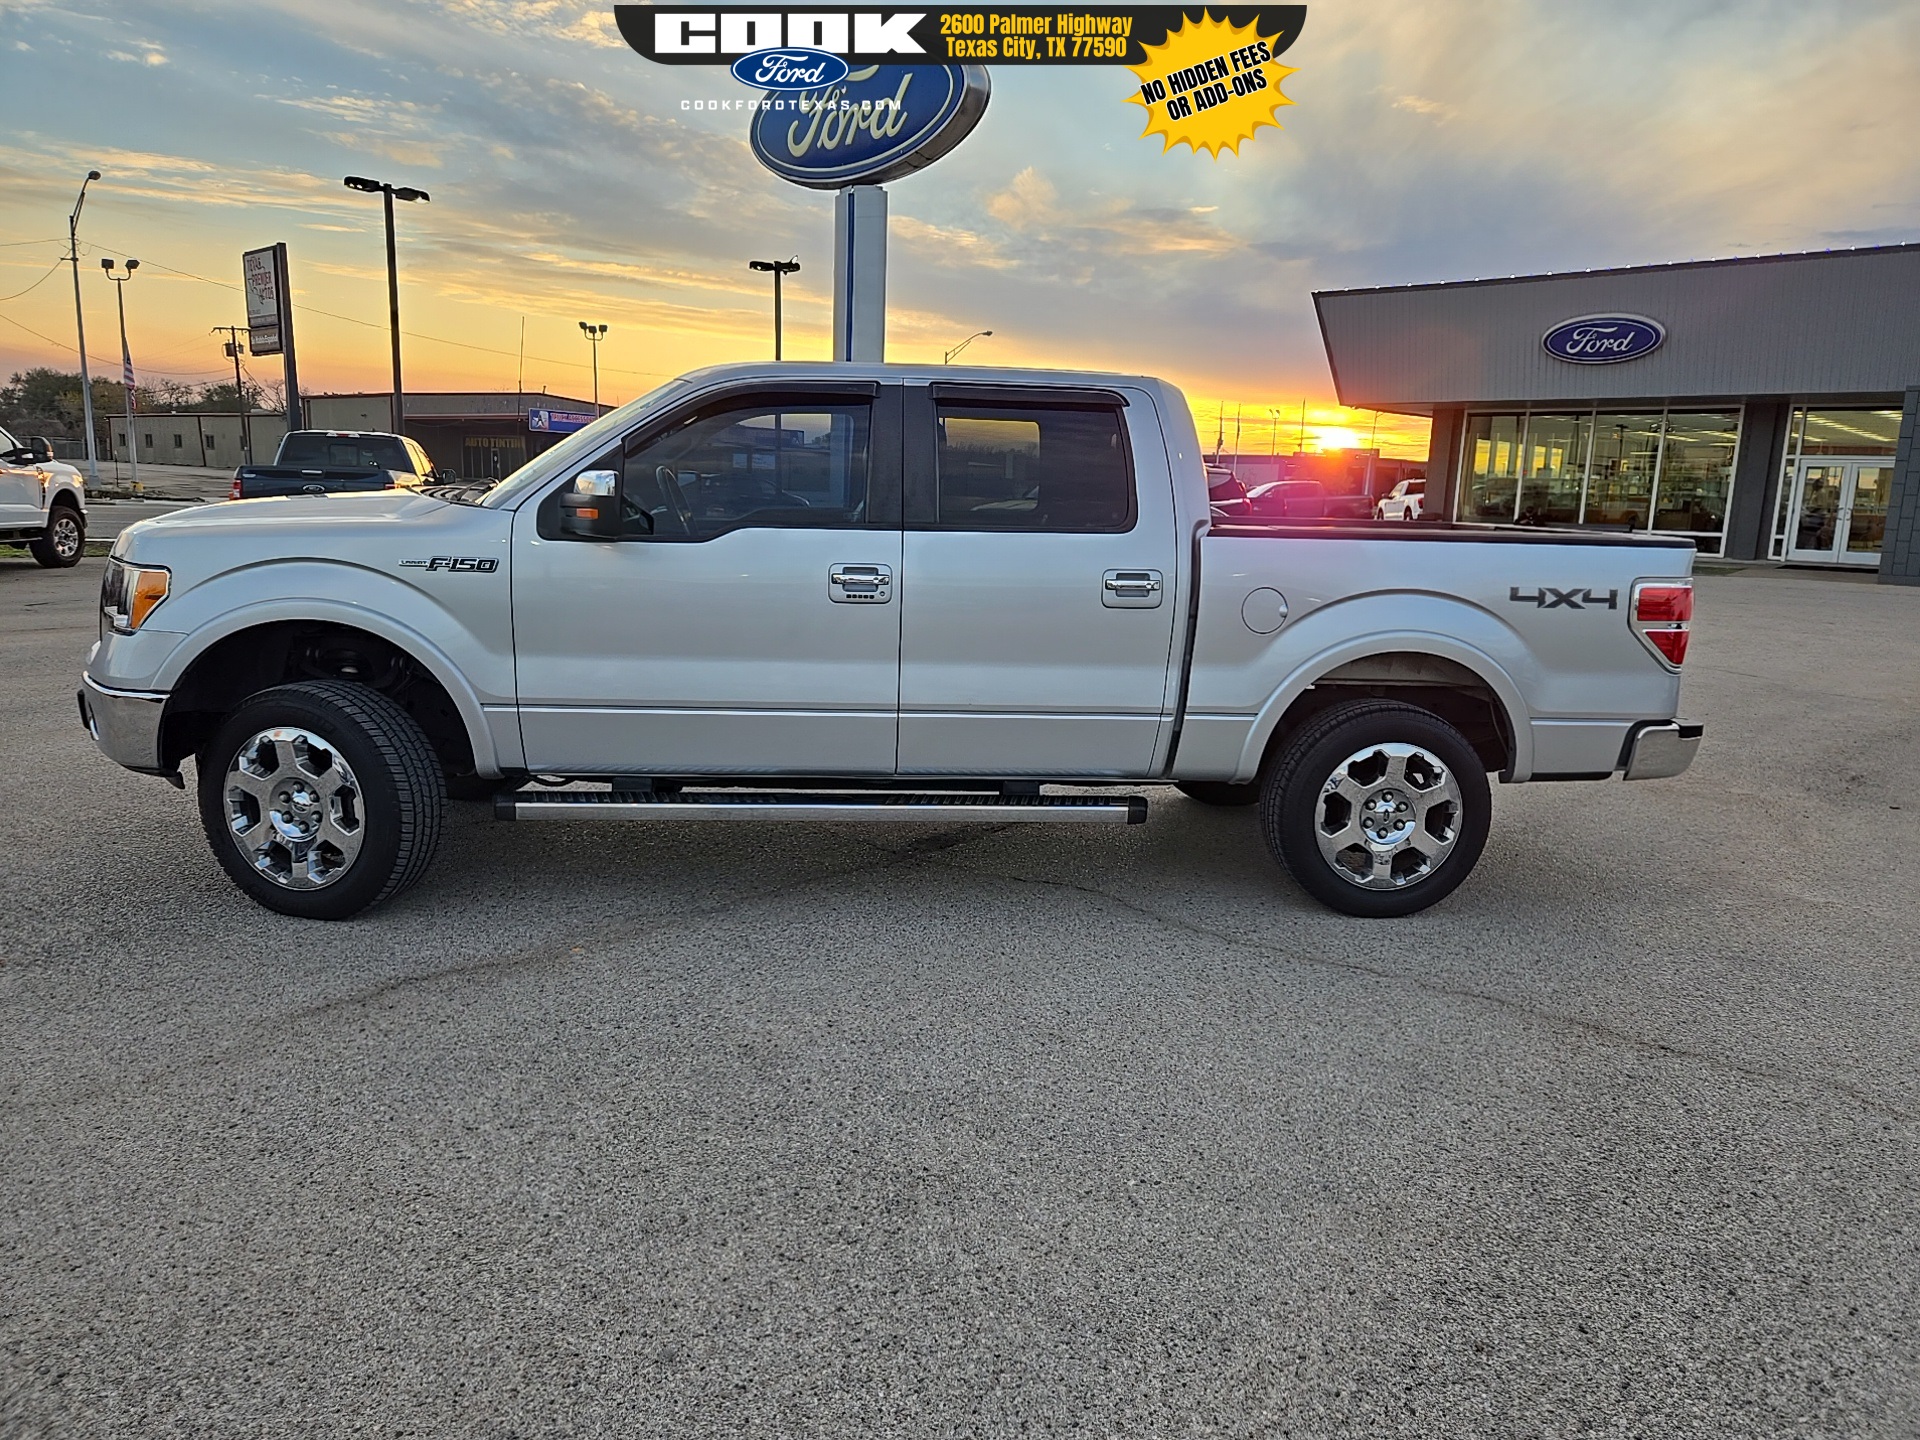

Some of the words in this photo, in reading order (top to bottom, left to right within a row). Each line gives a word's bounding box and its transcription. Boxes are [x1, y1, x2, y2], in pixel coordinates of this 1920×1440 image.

[787, 65, 914, 157] Ford
[1566, 326, 1635, 354] Ford
[426, 556, 499, 573] F-150
[1509, 586, 1618, 610] 4X4
